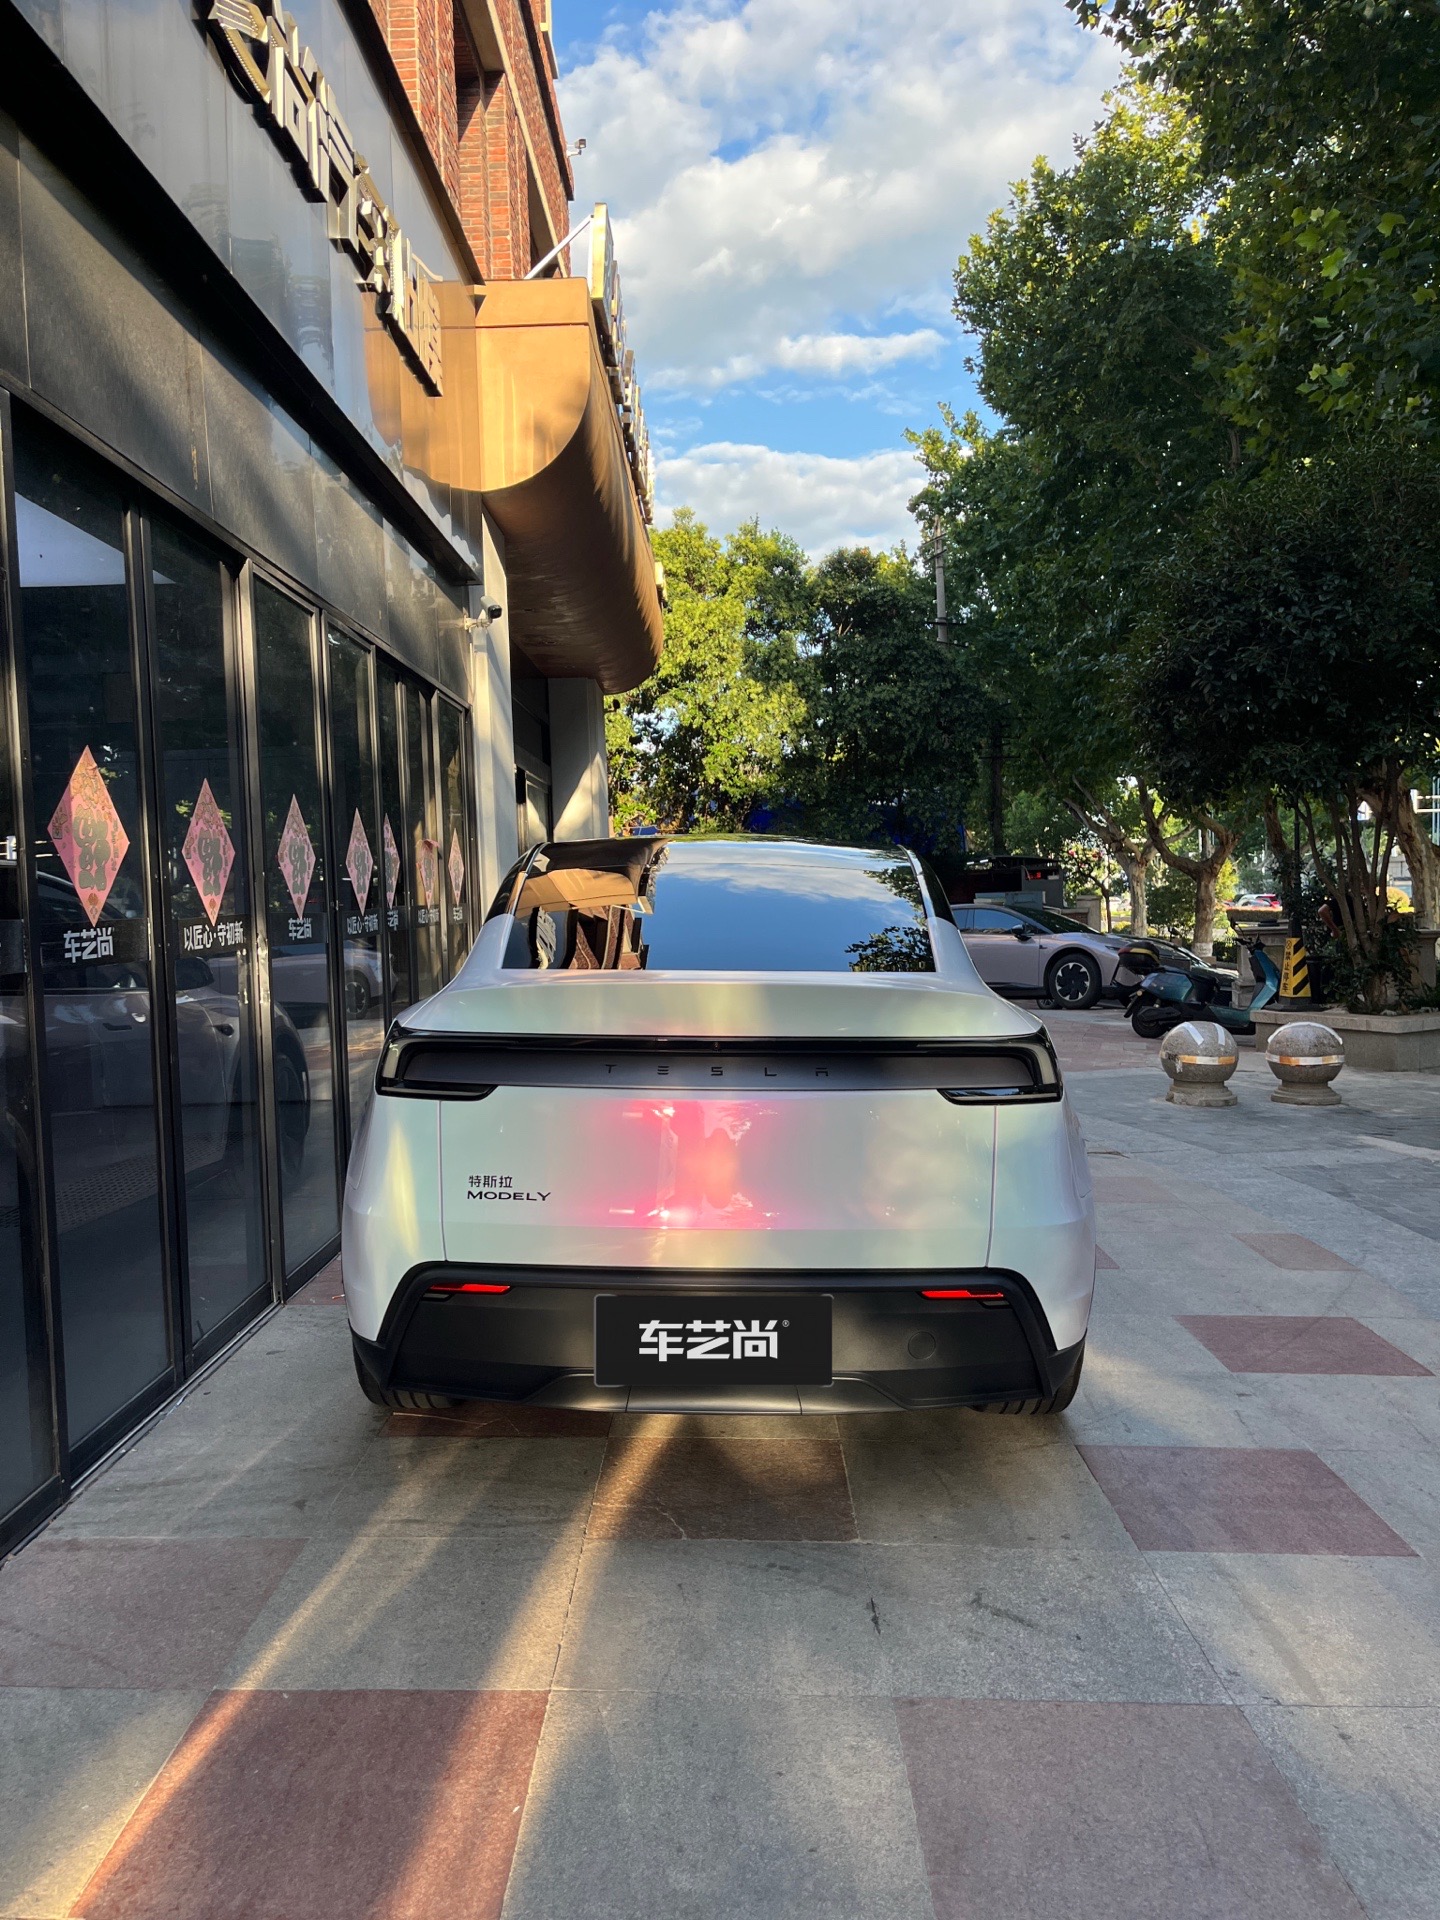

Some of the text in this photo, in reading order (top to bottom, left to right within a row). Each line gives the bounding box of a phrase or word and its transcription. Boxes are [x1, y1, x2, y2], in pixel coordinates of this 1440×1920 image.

[287, 917, 312, 941] 车艺尚
[63, 926, 114, 964] 车艺尚
[605, 1063, 829, 1077] TESLA
[468, 1175, 513, 1189] 特斯拉
